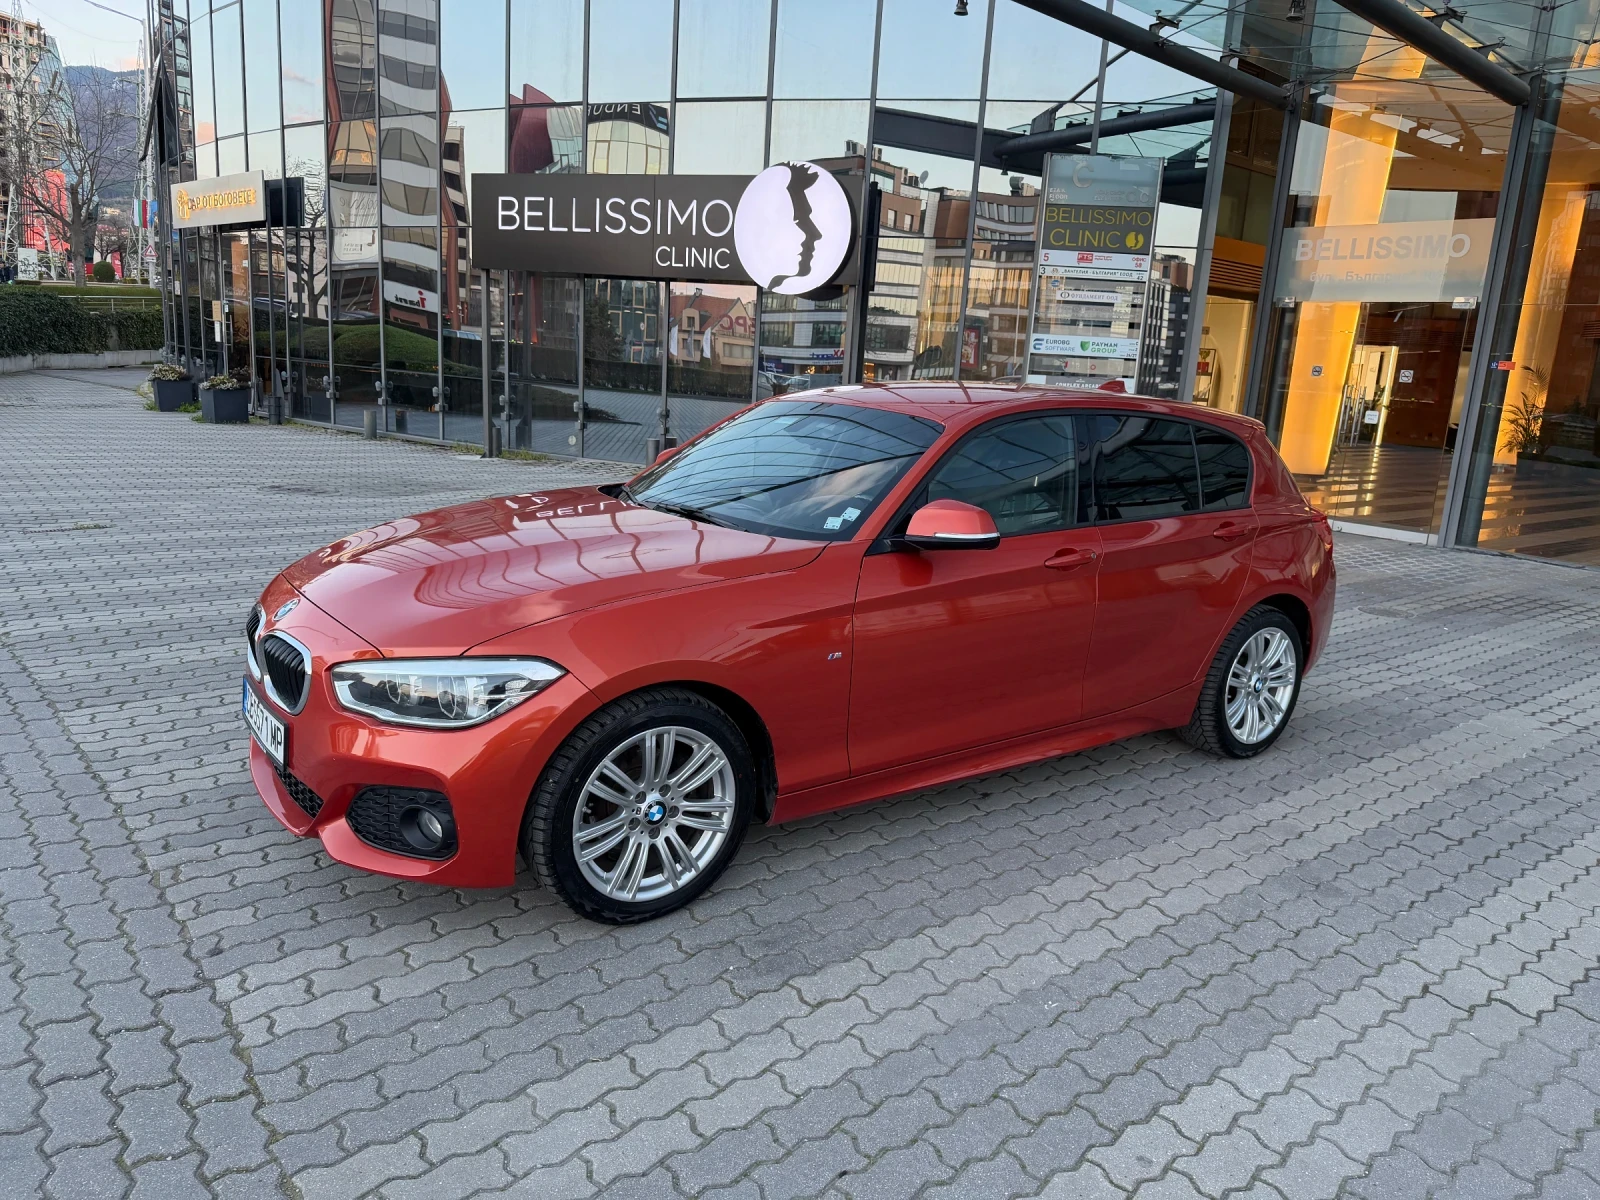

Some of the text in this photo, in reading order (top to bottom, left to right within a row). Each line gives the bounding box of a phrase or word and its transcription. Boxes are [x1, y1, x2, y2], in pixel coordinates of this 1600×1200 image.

[202, 194, 212, 208] ОТ
[213, 189, 252, 206] БОГОВЕТЕ
[497, 196, 734, 238] BELLISSIMO
[1045, 207, 1152, 227] BELLISSIMO
[1049, 228, 1121, 248] CLINIC
[1295, 233, 1471, 262] BELLISSIMO
[655, 245, 731, 269] CLINIC
[1043, 252, 1050, 262] 5
[1040, 266, 1046, 275] 3
